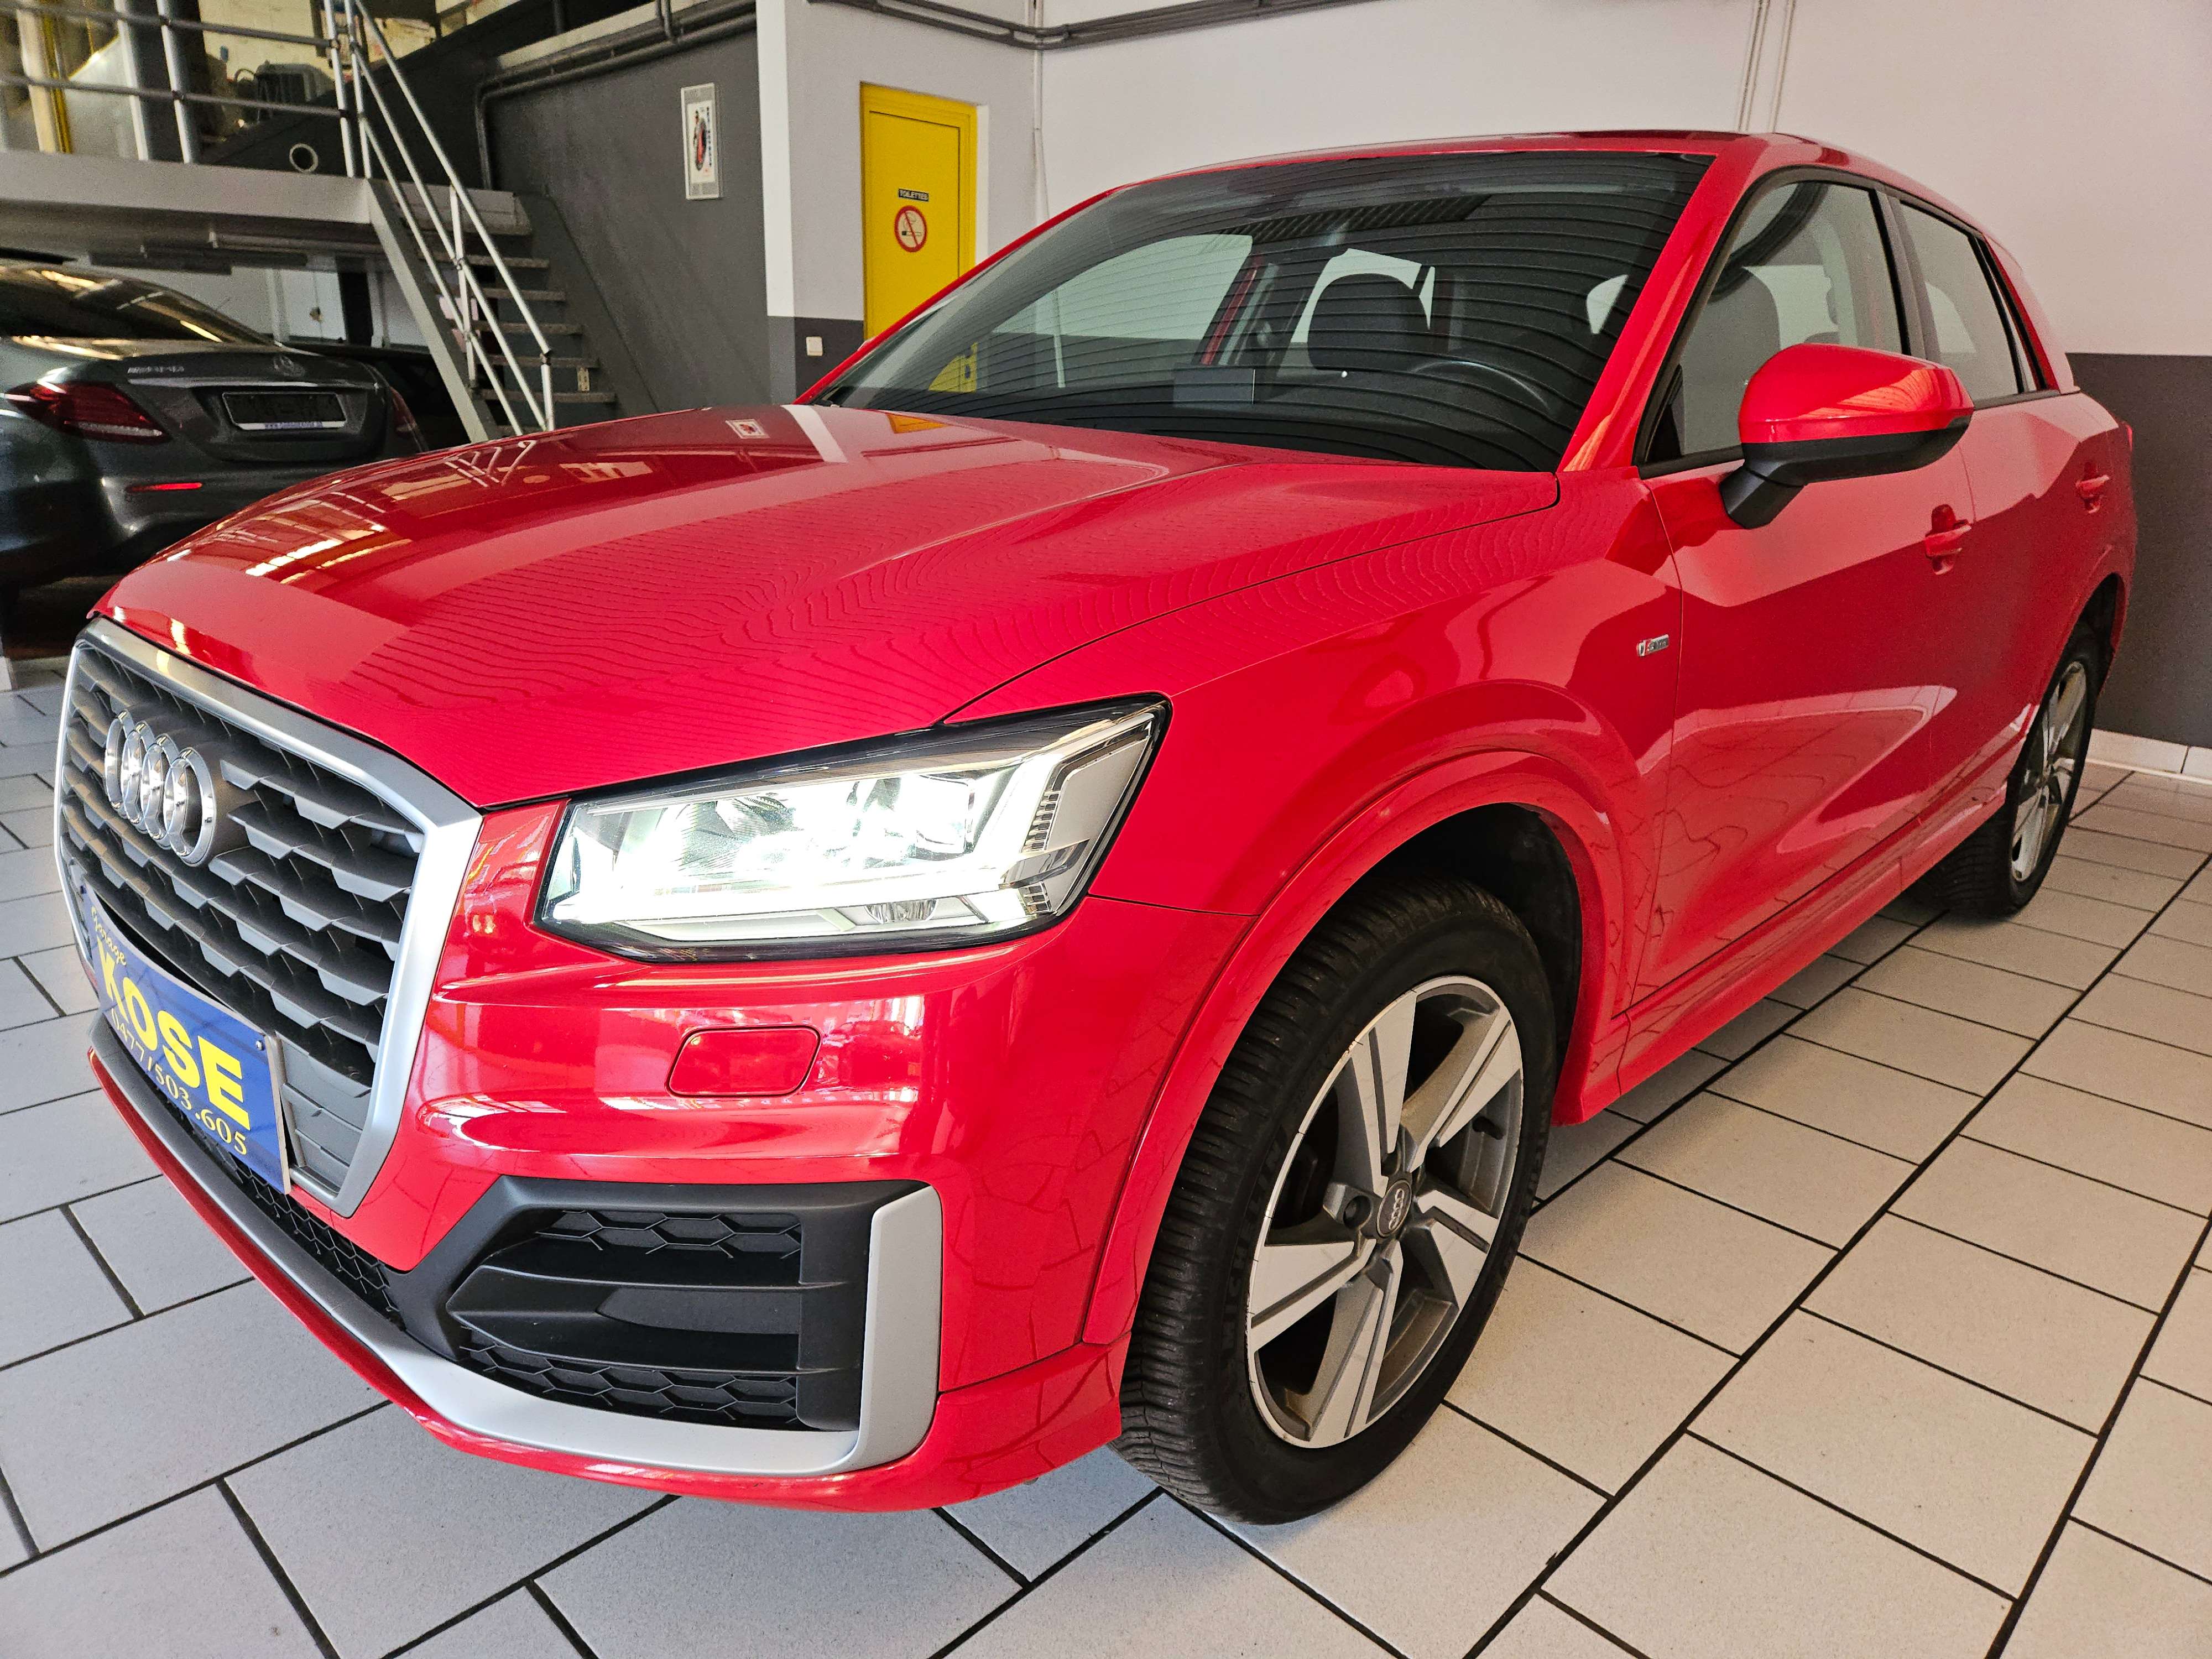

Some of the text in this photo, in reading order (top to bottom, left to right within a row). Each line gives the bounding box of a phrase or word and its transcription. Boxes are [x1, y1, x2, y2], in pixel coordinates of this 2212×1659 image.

[91, 907, 127, 966] Garage
[97, 936, 251, 1130] KOSE
[1222, 1139, 1281, 1350] MICHELIN
